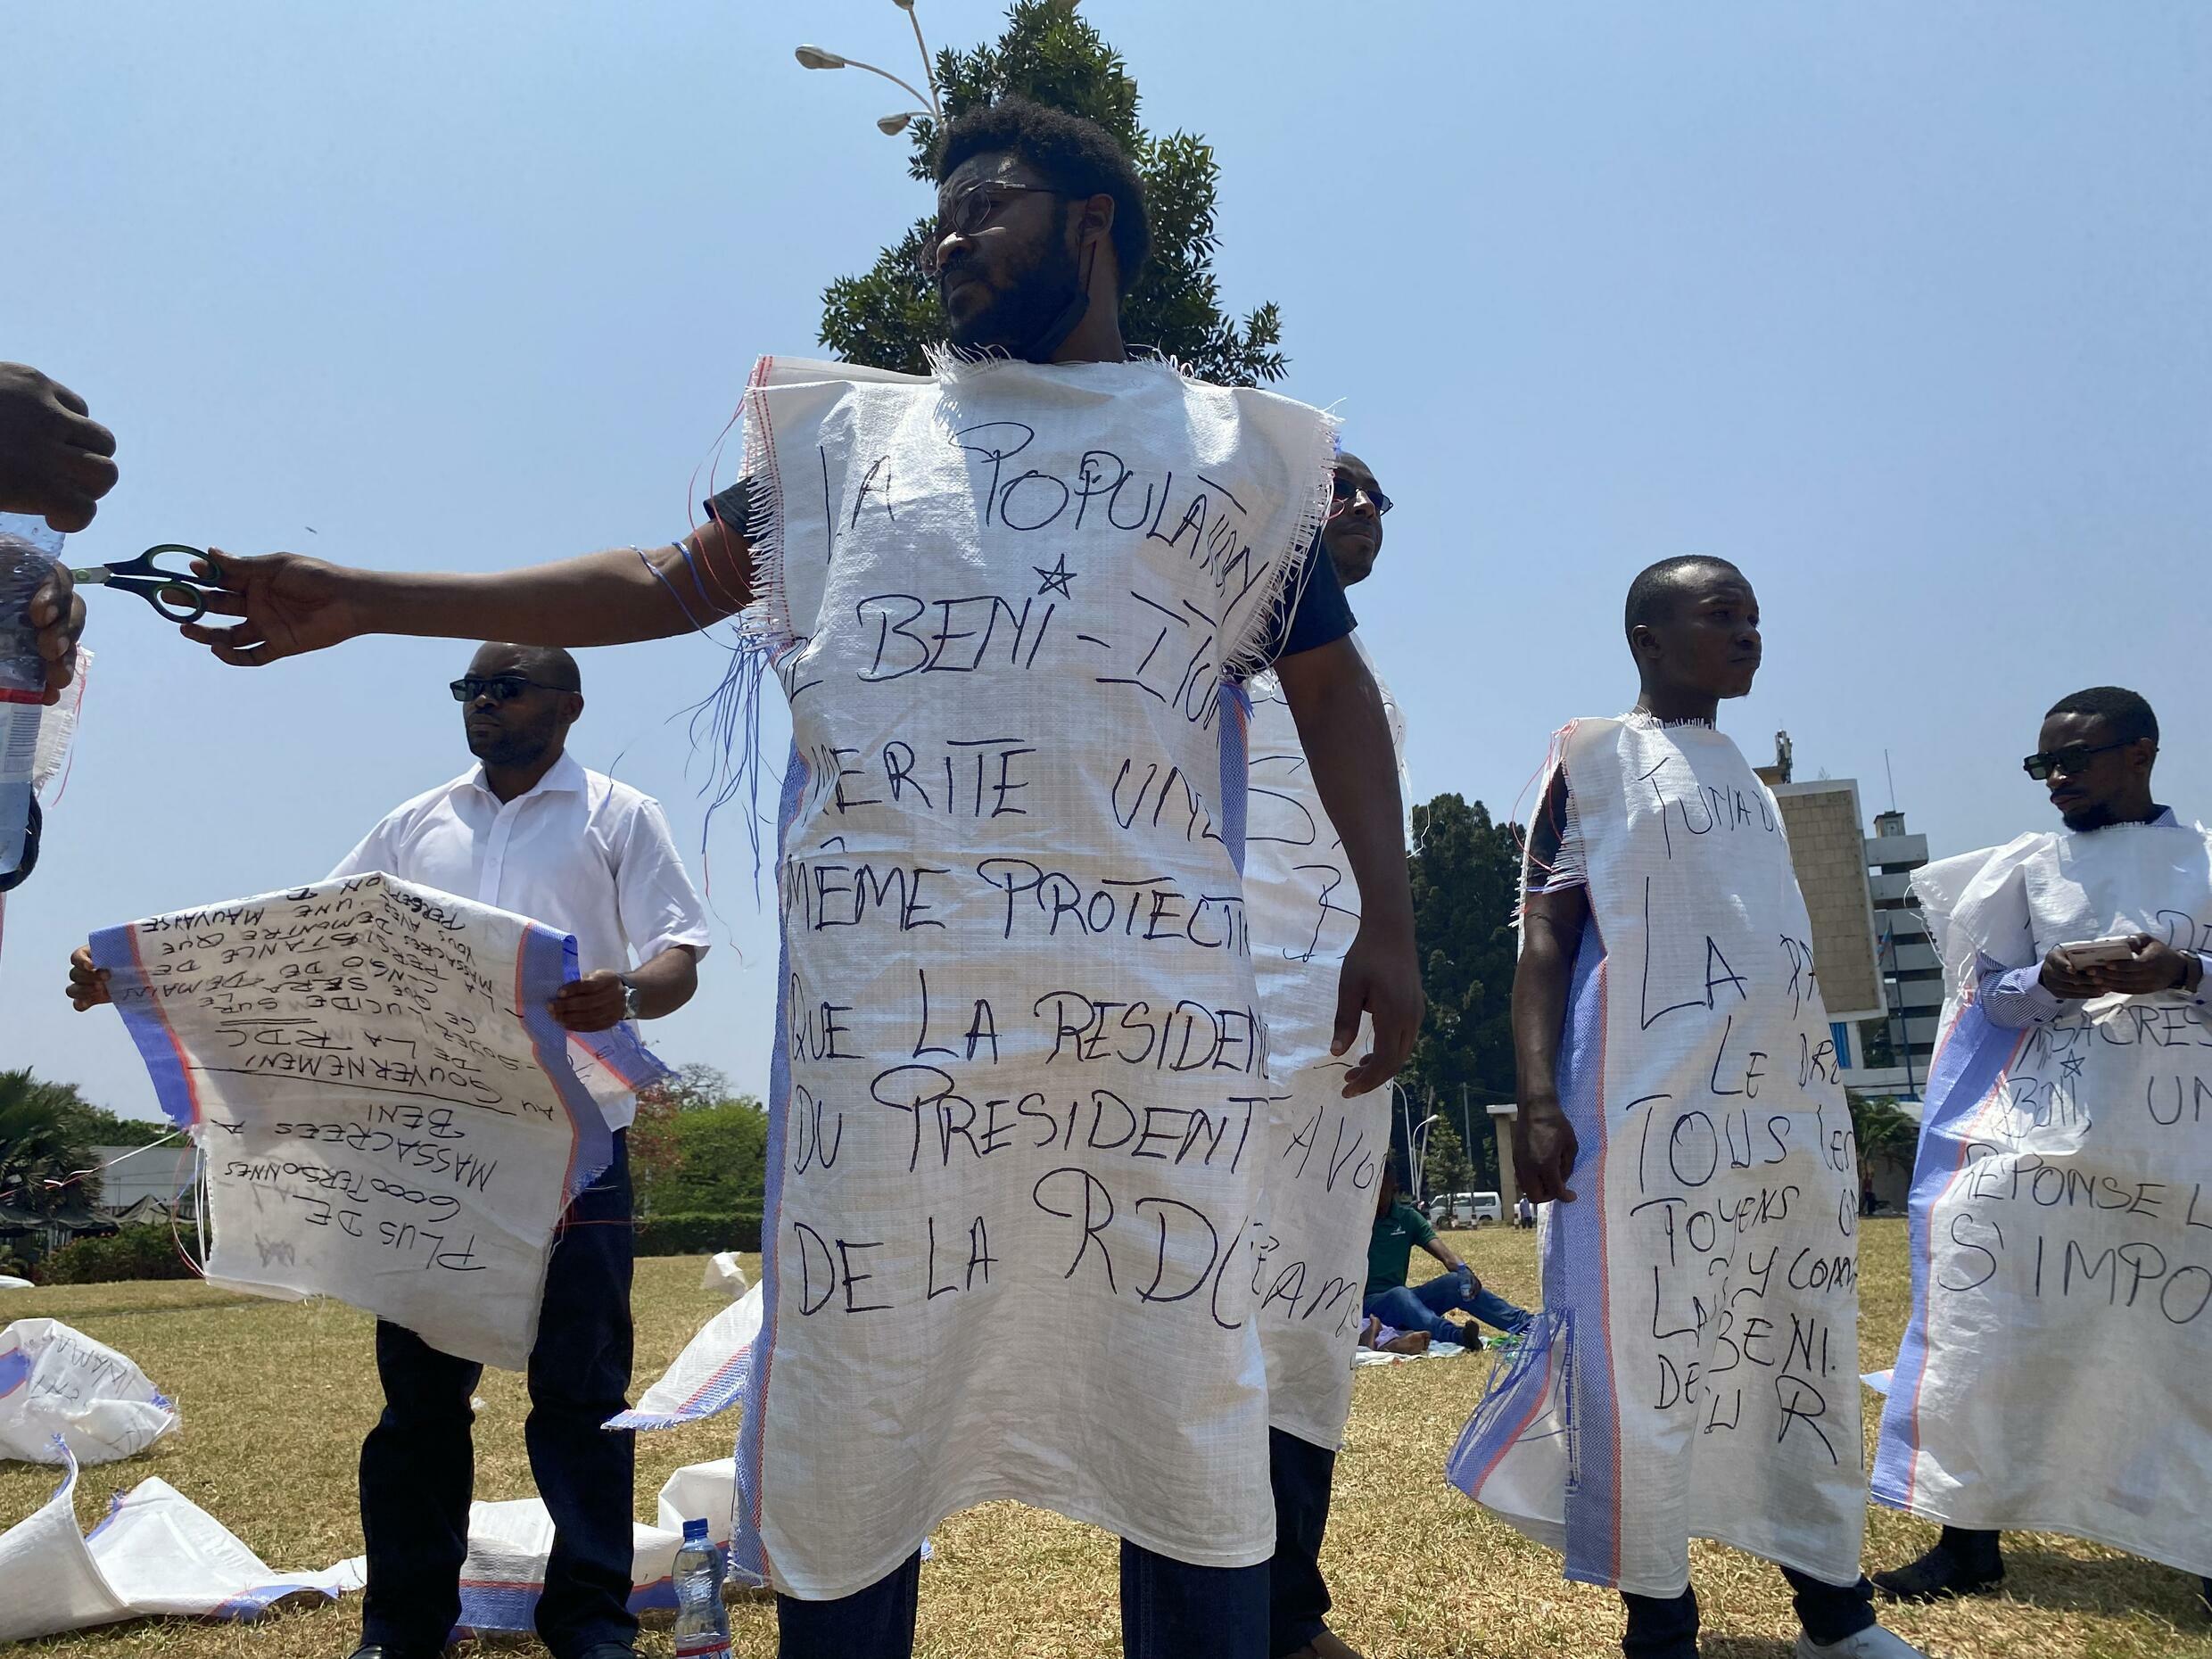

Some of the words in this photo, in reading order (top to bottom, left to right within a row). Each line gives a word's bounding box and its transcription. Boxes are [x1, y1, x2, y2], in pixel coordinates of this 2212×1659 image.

[820, 444, 896, 565] LA
[856, 592, 1056, 683] BENI
[139, 907, 266, 933] MAUVAISE
[293, 898, 354, 919] UNE
[161, 933, 224, 955] QUE
[1641, 876, 1749, 1032] LA
[150, 958, 202, 977] DE
[279, 961, 324, 978] DE
[198, 993, 234, 1008] LE
[392, 985, 432, 1011] QUE
[465, 983, 496, 1013] LA
[305, 995, 429, 1034] LUCIDE
[444, 1011, 476, 1035] CE
[790, 970, 864, 1063] QUE
[913, 969, 999, 1062] LA
[214, 1028, 353, 1051] RDC
[364, 1032, 417, 1060] LA
[433, 1048, 482, 1072] DE
[1711, 1015, 1768, 1099] LE
[210, 1118, 247, 1135] A
[367, 1104, 466, 1138] BENI
[521, 1100, 555, 1121] AU
[794, 1084, 843, 1175] DU
[870, 1064, 1270, 1174] PRESIDENT
[1625, 1094, 1791, 1194] TOUS
[225, 1161, 369, 1202] PERSONNES
[293, 1194, 363, 1237] DE
[370, 1177, 461, 1223] 6000
[378, 1221, 486, 1271] PLUS
[793, 1221, 893, 1316] DE
[928, 1217, 998, 1300] LA
[1033, 1166, 1249, 1330] RDC
